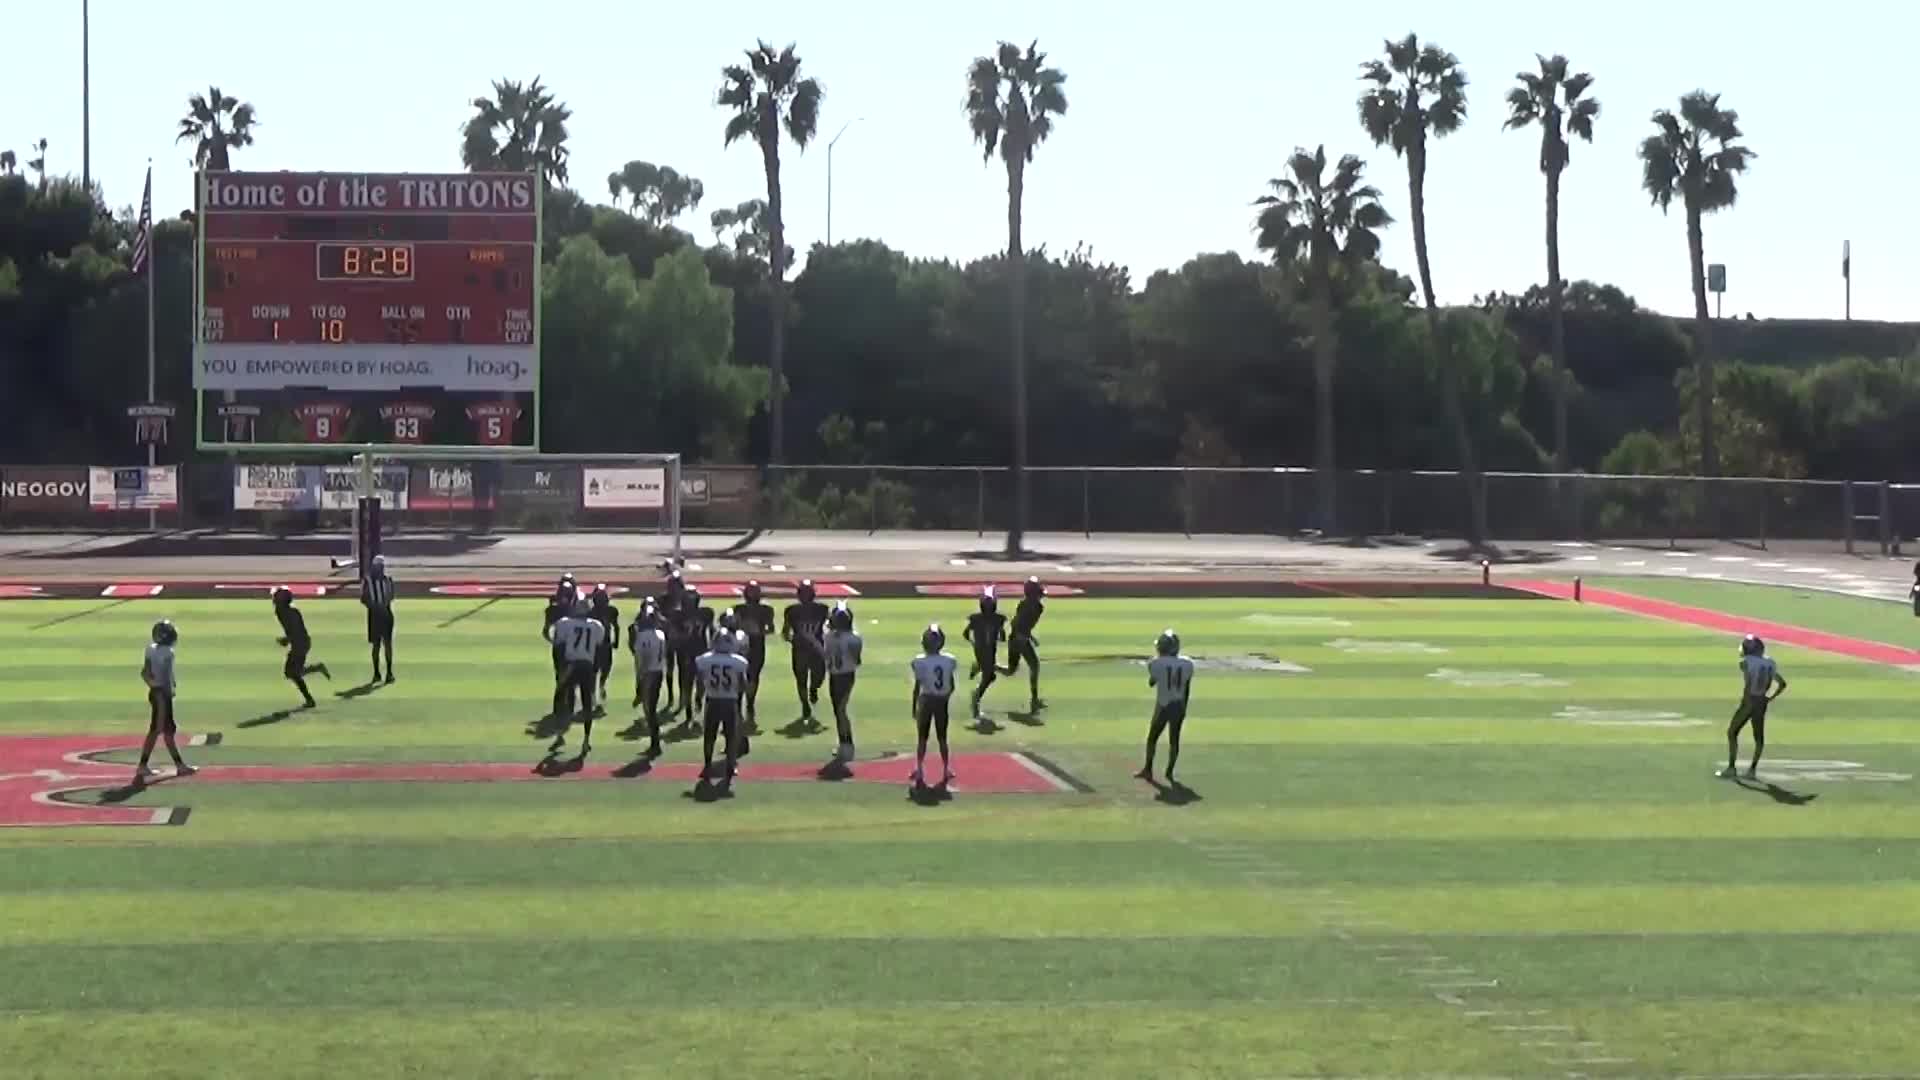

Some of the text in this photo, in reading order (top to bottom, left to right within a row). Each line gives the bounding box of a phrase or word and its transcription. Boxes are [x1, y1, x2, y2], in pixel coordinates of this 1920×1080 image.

[204, 177, 531, 209] Home of the TRITONS
[252, 306, 290, 319] DOWN
[311, 306, 346, 319] TO GO
[381, 305, 408, 319] BALL
[273, 321, 279, 340] 1
[320, 320, 343, 342] 10
[202, 359, 237, 375] YOU
[246, 359, 353, 376] EMPOWERED
[357, 360, 377, 375] BY
[395, 417, 419, 439] 63
[487, 417, 501, 439] 5
[1, 481, 87, 497] NEOGOV
[573, 627, 592, 648] 71
[709, 665, 733, 690] 55
[933, 665, 945, 690] 3
[1166, 666, 1184, 691] 14
